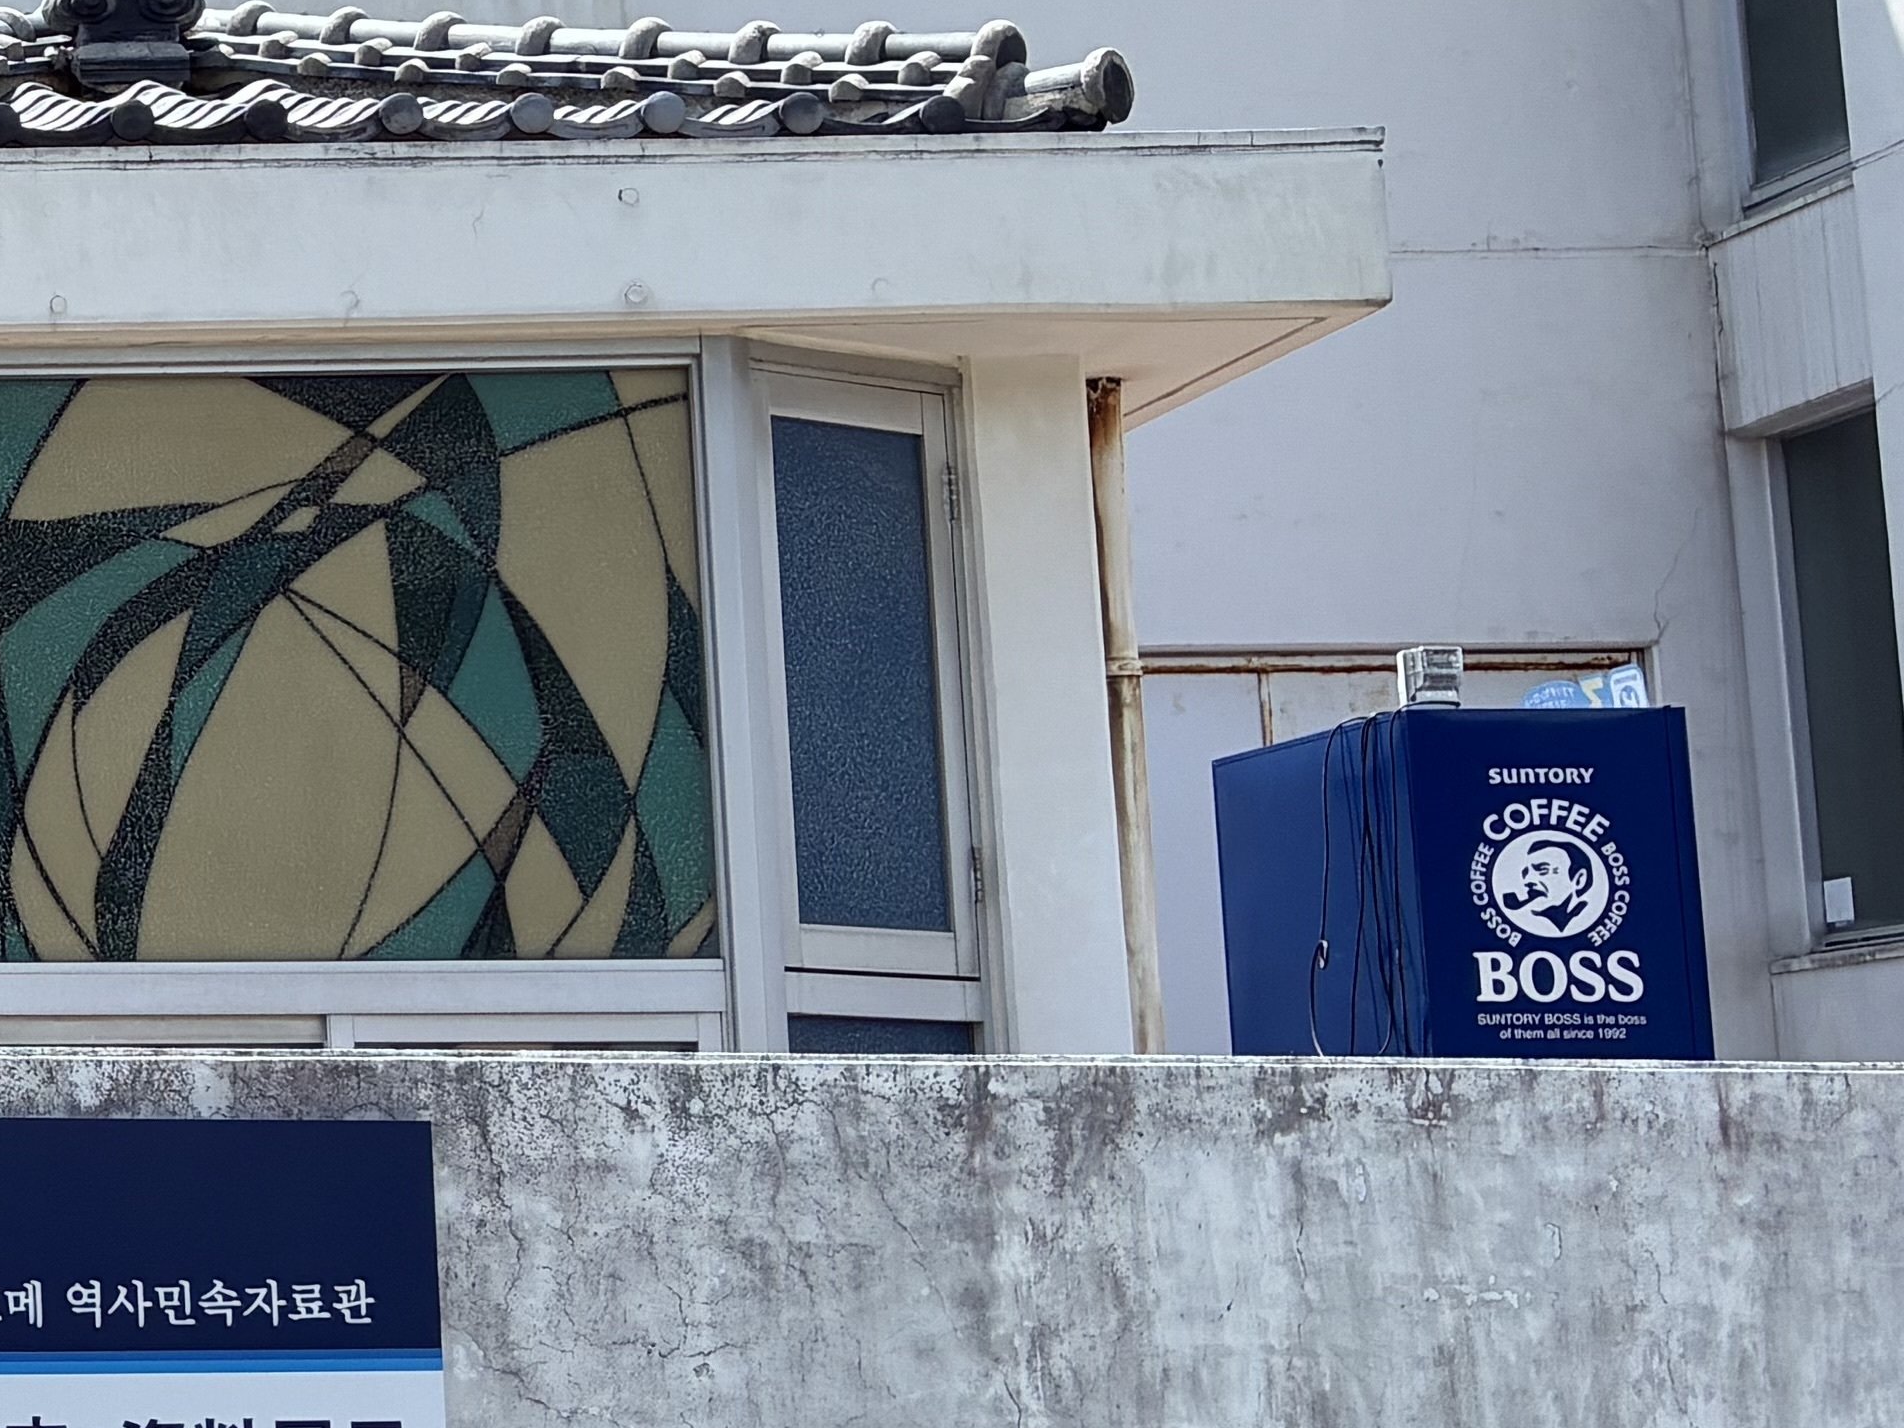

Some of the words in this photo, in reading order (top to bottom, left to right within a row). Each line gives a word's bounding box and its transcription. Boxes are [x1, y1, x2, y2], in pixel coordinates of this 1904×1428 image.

[1488, 767, 1594, 785] SUNTORY
[1483, 798, 1610, 842] COFFEE
[1470, 842, 1494, 906] COFFEE
[1600, 841, 1630, 886] BOSS
[1481, 907, 1522, 948] BOSS
[1587, 890, 1630, 947] COFFEE
[1473, 950, 1644, 1003] BOSS
[1477, 1012, 1542, 1025] SUNTORY
[1544, 1012, 1582, 1025] BOSS
[1584, 1013, 1594, 1025] is
[1597, 1014, 1616, 1025] the
[1617, 1013, 1648, 1025] boss
[1499, 1027, 1512, 1039] of
[1514, 1028, 1544, 1039] them
[1546, 1027, 1561, 1039] all
[1563, 1029, 1594, 1039] since
[1598, 1027, 1627, 1039] 1992
[66, 1278, 376, 1329] 역사민속자료관
